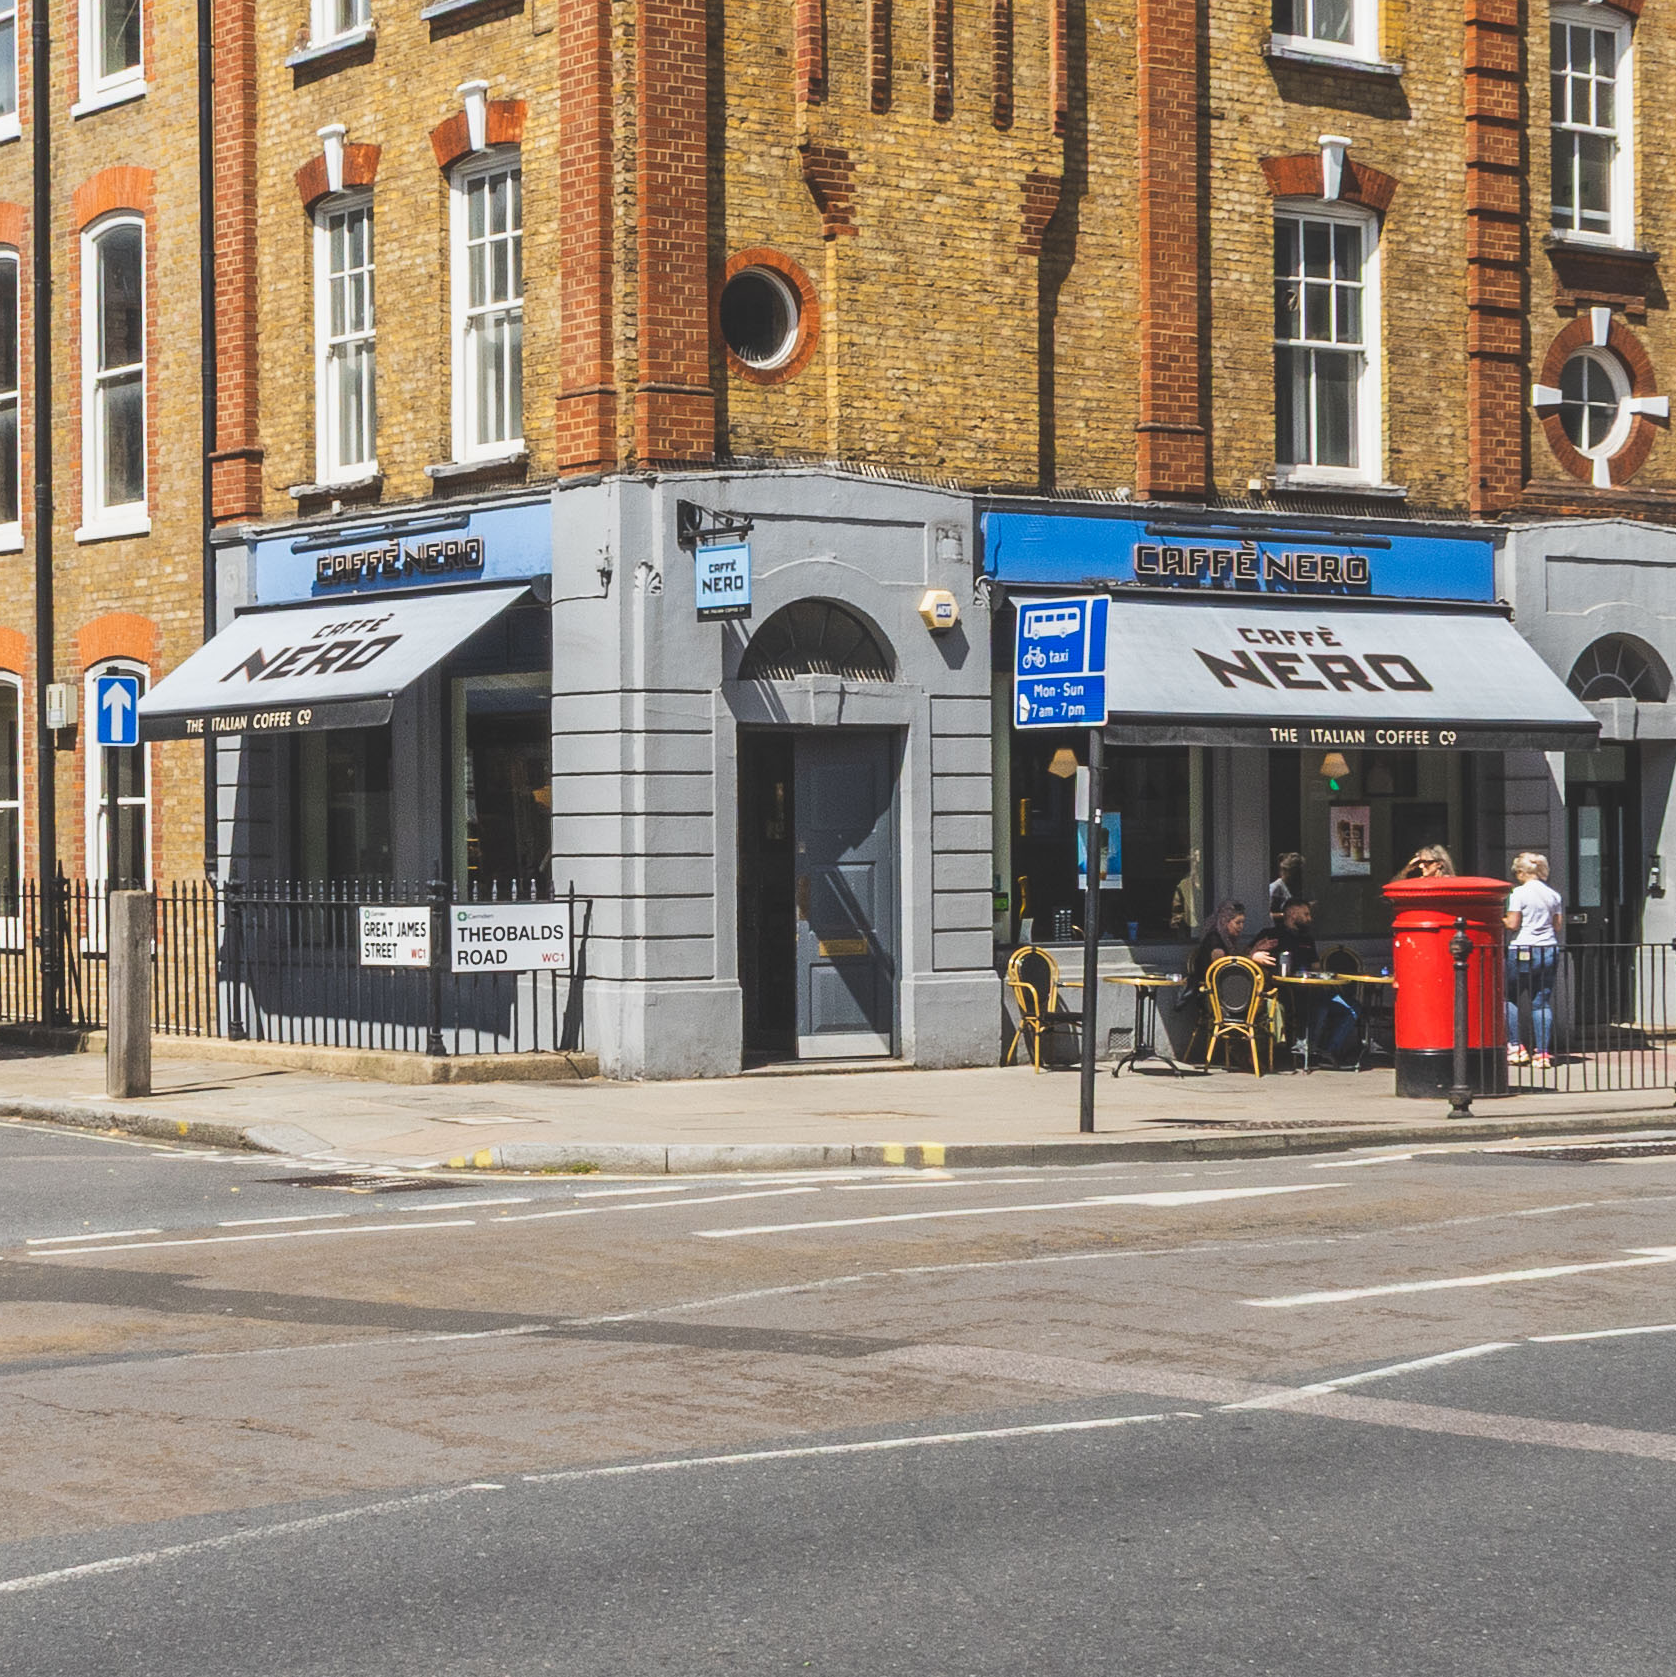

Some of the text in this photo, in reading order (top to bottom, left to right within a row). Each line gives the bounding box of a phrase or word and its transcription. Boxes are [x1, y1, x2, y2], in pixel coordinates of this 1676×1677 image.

[402, 536, 485, 573] NERO
[1134, 540, 1369, 585] CAFFÈ NERO
[702, 575, 743, 594] NERO
[1237, 625, 1343, 647] CAFFÈ
[219, 634, 403, 683] NERO
[1049, 649, 1069, 664] taxi
[1193, 648, 1433, 692] NERO
[1034, 684, 1056, 697] Mon
[1063, 682, 1084, 696] Sun
[1031, 704, 1054, 718] 7am
[1061, 703, 1085, 718] 7pm
[186, 718, 204, 733] THE
[211, 715, 248, 732] ITALIAN
[253, 711, 291, 729] COFFEE
[1270, 728, 1298, 742] THE
[1311, 728, 1365, 744] ITALIAN
[1376, 729, 1429, 745] COFFEE
[364, 922, 426, 937] GREAT JAMES
[457, 925, 564, 942] THEOBALDS
[364, 943, 398, 958] STREET
[411, 948, 426, 959] WC1
[457, 949, 508, 965] ROAD
[541, 953, 565, 962] WC1
